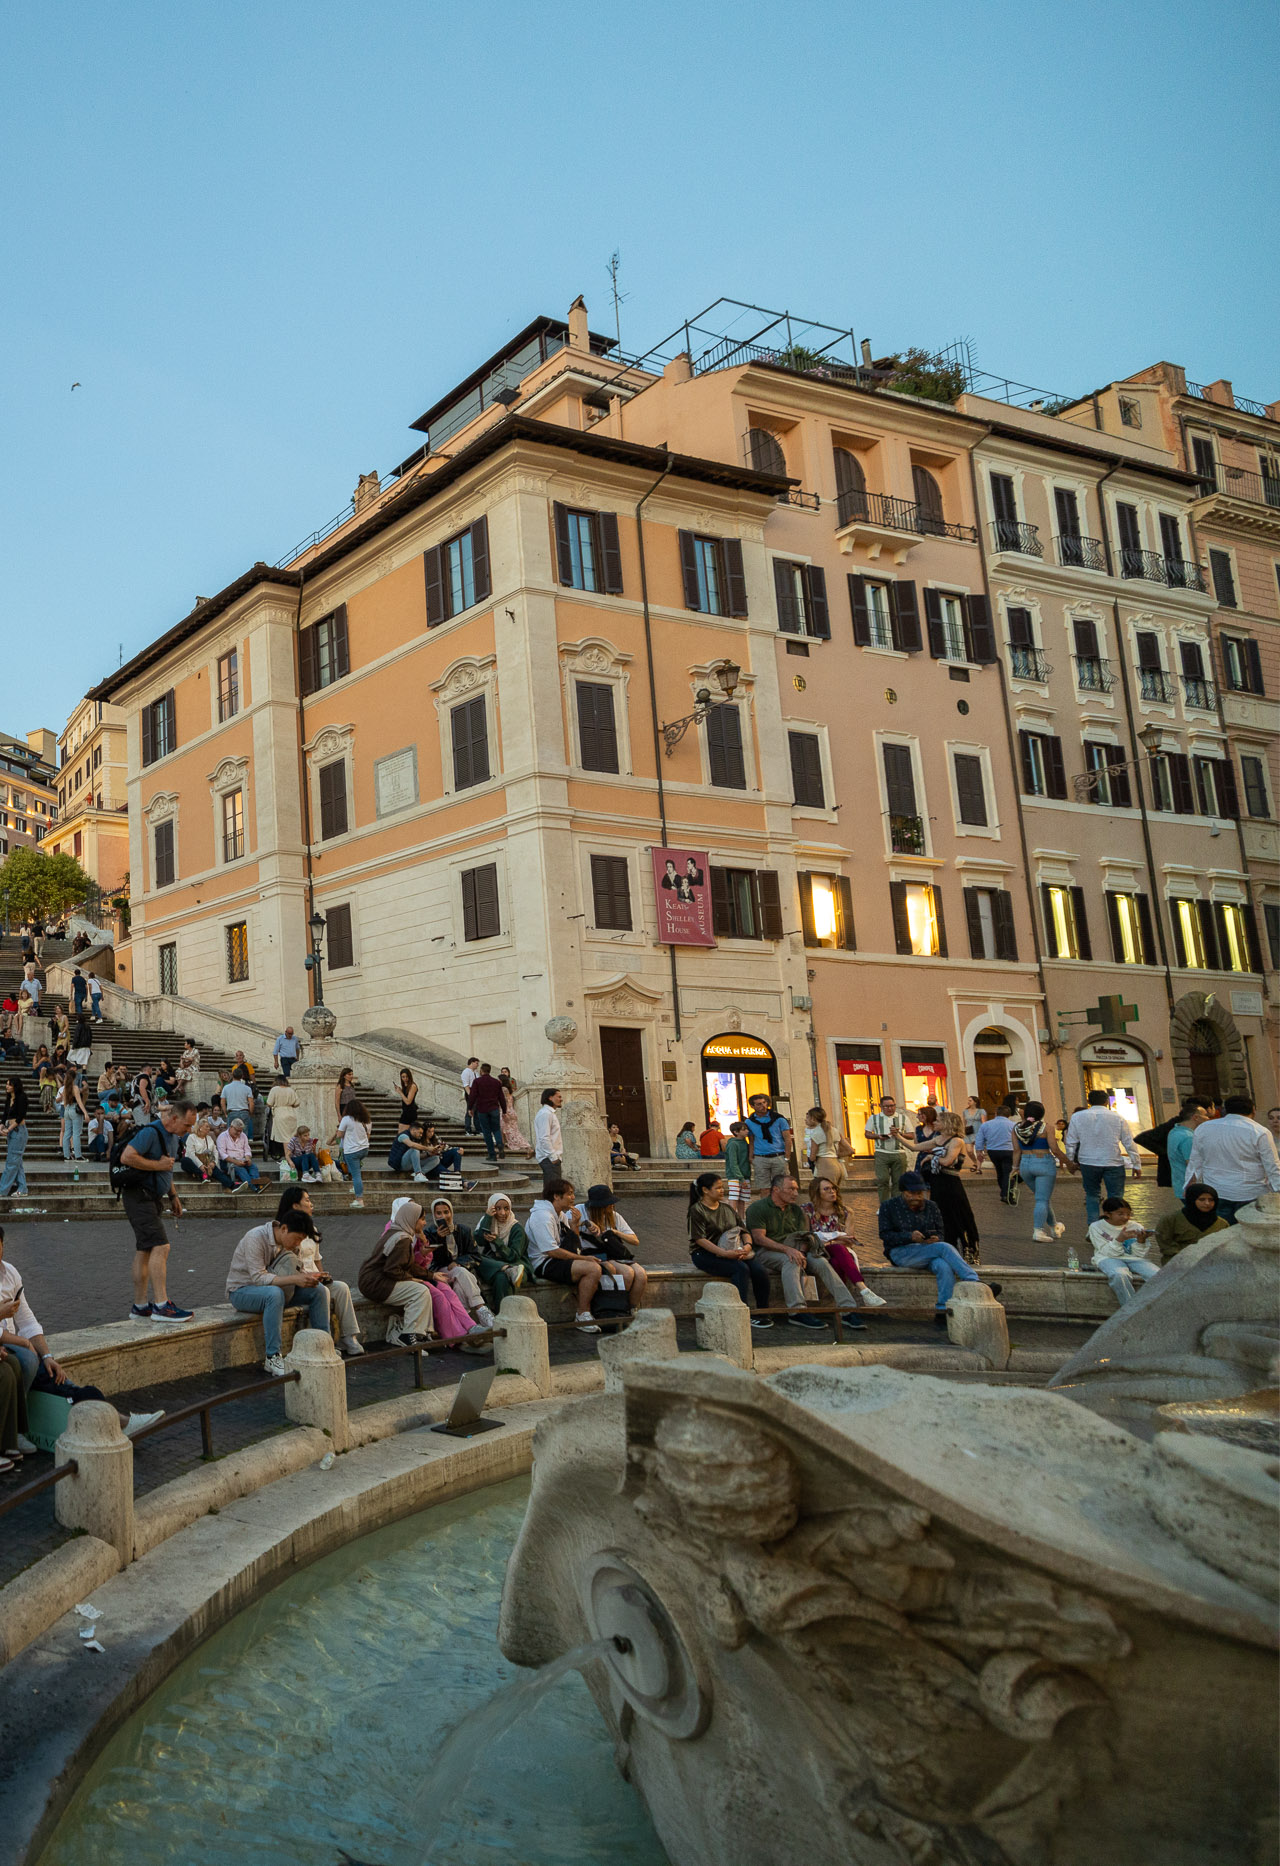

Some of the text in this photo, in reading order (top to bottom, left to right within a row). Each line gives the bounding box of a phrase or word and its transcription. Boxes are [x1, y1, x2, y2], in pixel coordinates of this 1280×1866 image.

[696, 893, 707, 935] MUSEUM
[706, 1045, 733, 1055] ACQUA
[741, 1046, 767, 1056] PARMA
[852, 1063, 870, 1072] CAMPER
[917, 1065, 935, 1073] CAMPER
